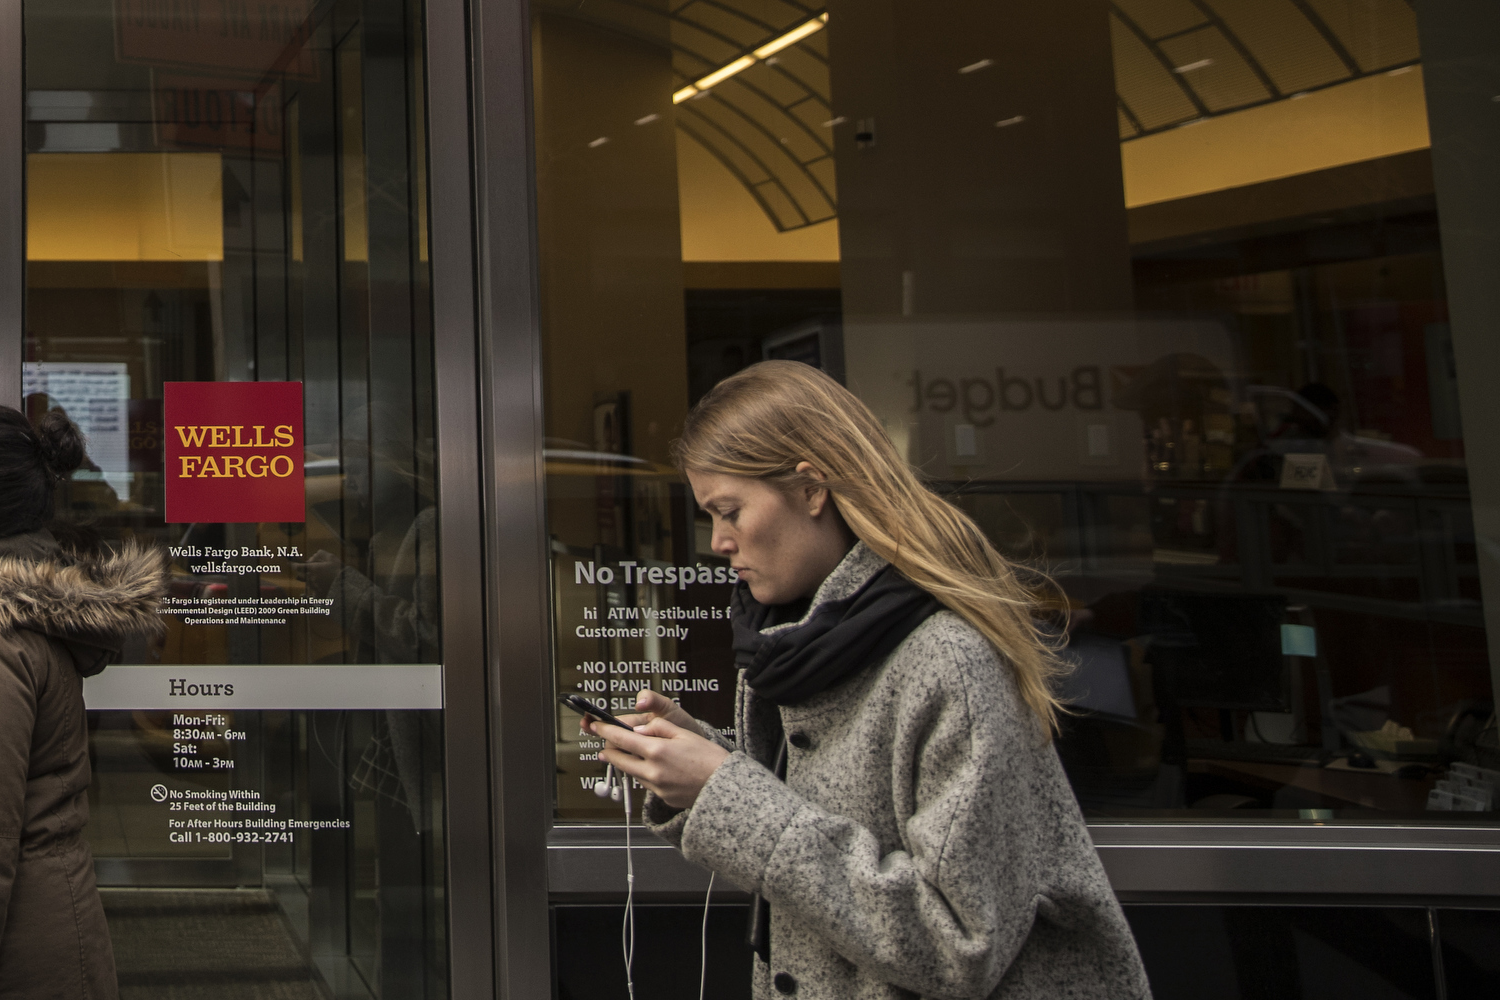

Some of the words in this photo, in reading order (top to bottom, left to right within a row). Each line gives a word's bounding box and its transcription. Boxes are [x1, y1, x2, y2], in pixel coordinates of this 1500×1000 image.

[175, 424, 294, 450] WELLS
[178, 453, 294, 480] FARGO
[168, 546, 202, 558] Wells
[204, 546, 239, 560] Fargo
[241, 546, 275, 559] Bank,
[277, 546, 304, 558] N.A.
[190, 562, 282, 576] wellsfargo.com
[574, 560, 614, 585] No
[619, 560, 740, 591] Trespass
[172, 597, 193, 607] Fargo
[193, 597, 200, 605] is
[200, 597, 237, 607] registered
[238, 597, 259, 605] under
[260, 597, 300, 607] Leadership
[301, 597, 308, 605] in
[309, 597, 335, 607] Energy
[208, 607, 234, 617] Design
[234, 607, 258, 617] (LEED)
[258, 607, 277, 615] 2009
[277, 607, 299, 615] Green
[300, 607, 331, 616] Building
[607, 607, 640, 620] ATM
[641, 606, 709, 620] Vestibule
[711, 606, 724, 620] is
[184, 617, 225, 626] Operations
[225, 617, 239, 625] and
[240, 617, 287, 625] Maintenance
[575, 625, 651, 638] Customers
[655, 624, 689, 641] Only
[609, 661, 687, 674] LOITERING
[169, 678, 235, 697] Hours
[173, 714, 226, 726] Mon-Fri:
[224, 729, 246, 740] 6PM
[173, 743, 198, 754] Sat:
[579, 739, 600, 749] who
[579, 751, 599, 761] and
[173, 757, 203, 769] 10AM
[212, 757, 235, 769] 3PM
[170, 790, 183, 799] No
[185, 790, 227, 801] Smoking
[228, 790, 261, 799] Within
[169, 803, 182, 812] 25
[183, 803, 205, 812] Feet
[206, 802, 217, 812] of
[217, 803, 235, 812] the
[236, 802, 277, 814] Building
[169, 819, 186, 829] For
[187, 819, 212, 829] After
[214, 819, 244, 829] Hours
[245, 819, 287, 830] Building
[288, 819, 351, 831] Emergencies
[169, 831, 193, 843] Call
[195, 831, 295, 843] 1-800-932-2741
